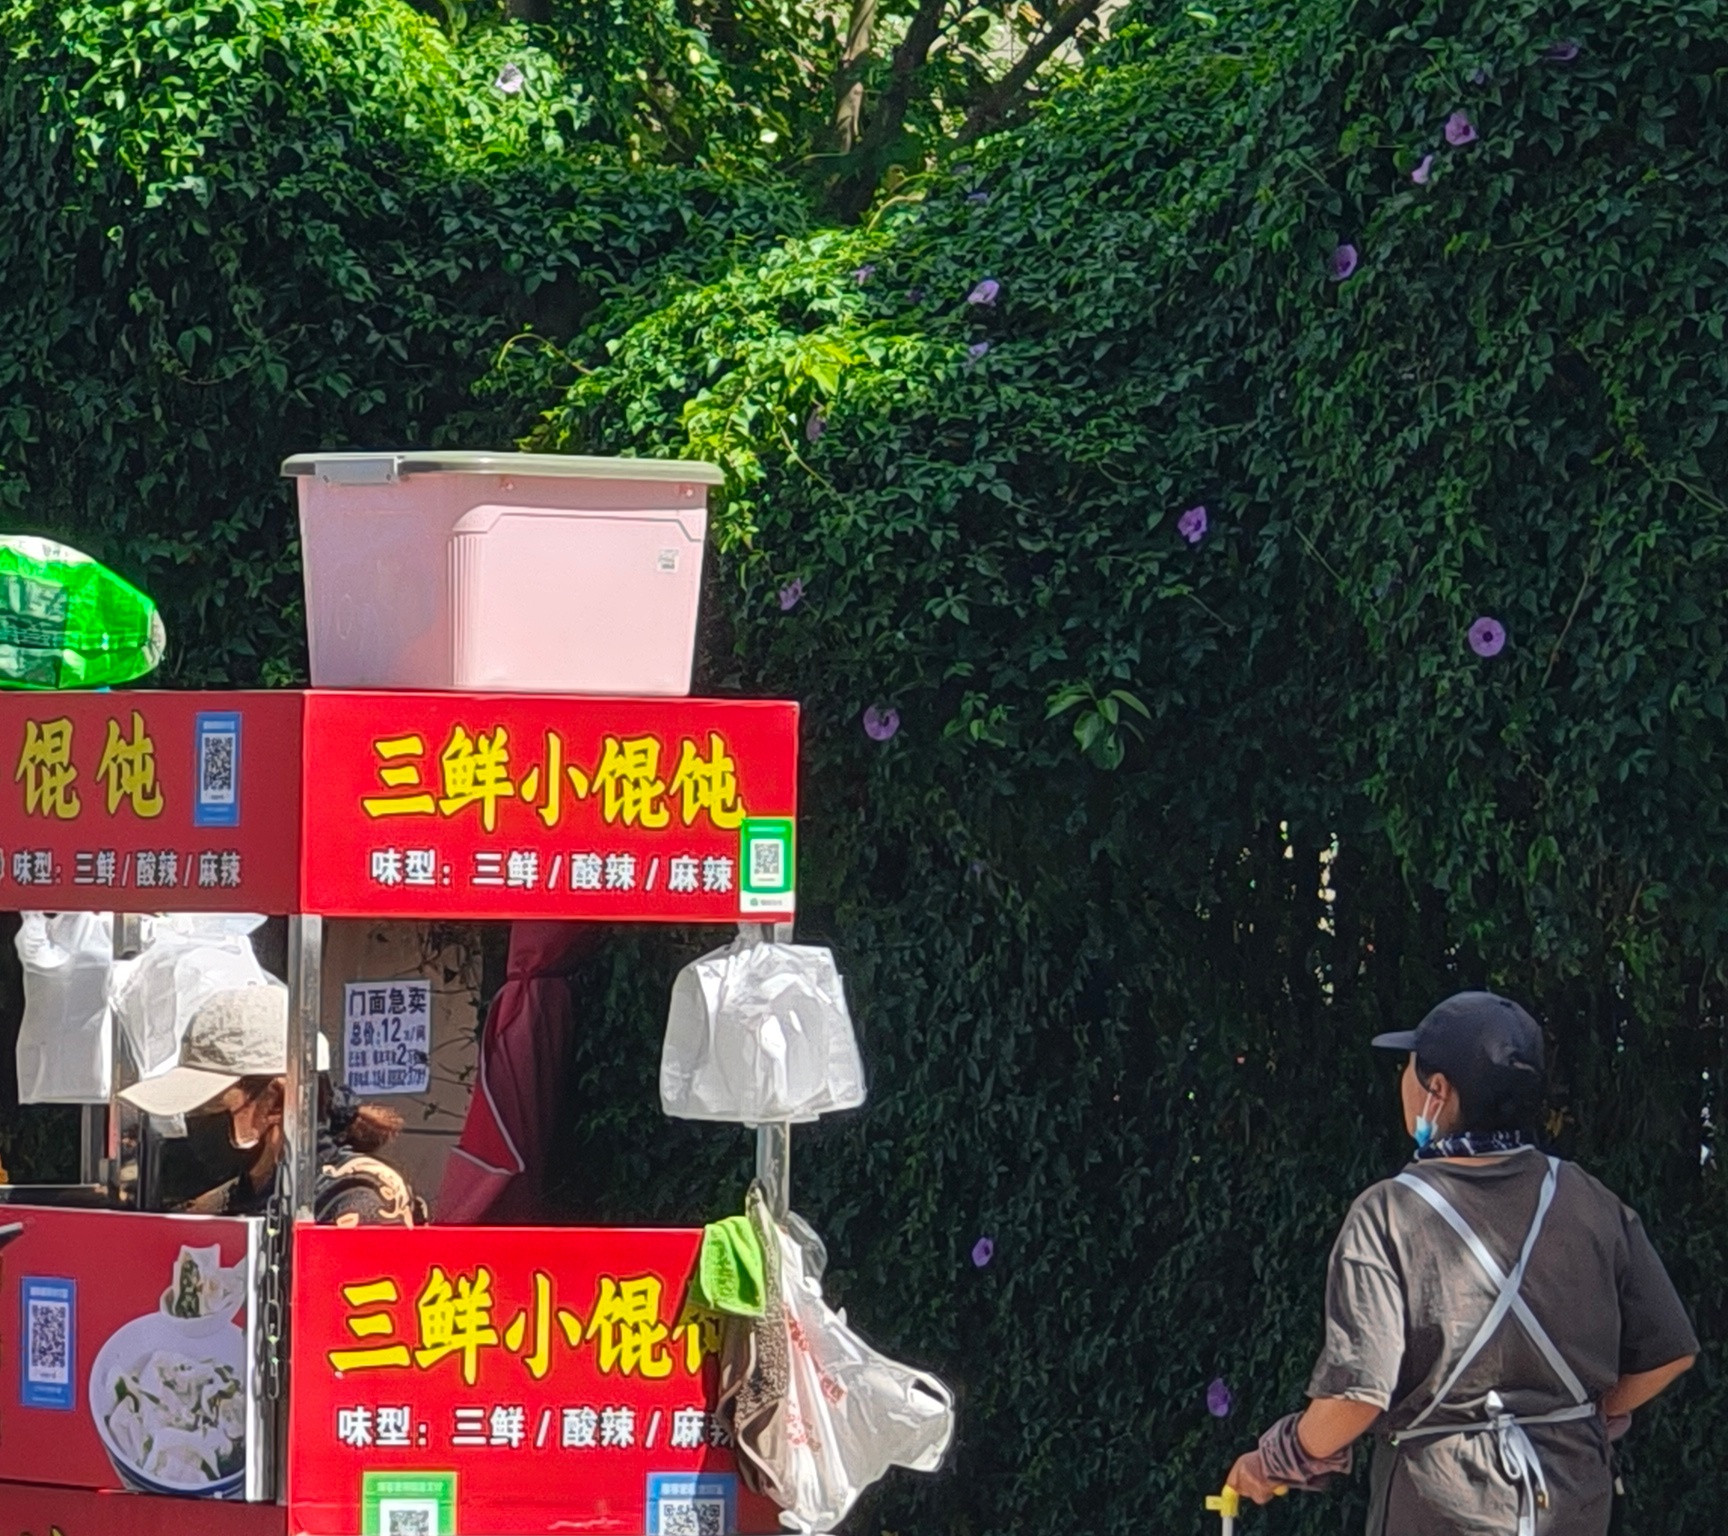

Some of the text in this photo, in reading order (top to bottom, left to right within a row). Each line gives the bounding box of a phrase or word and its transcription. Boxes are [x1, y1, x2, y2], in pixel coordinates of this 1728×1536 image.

[363, 725, 748, 832] 三鲜小馄饨
[349, 986, 427, 1016] 门面急卖
